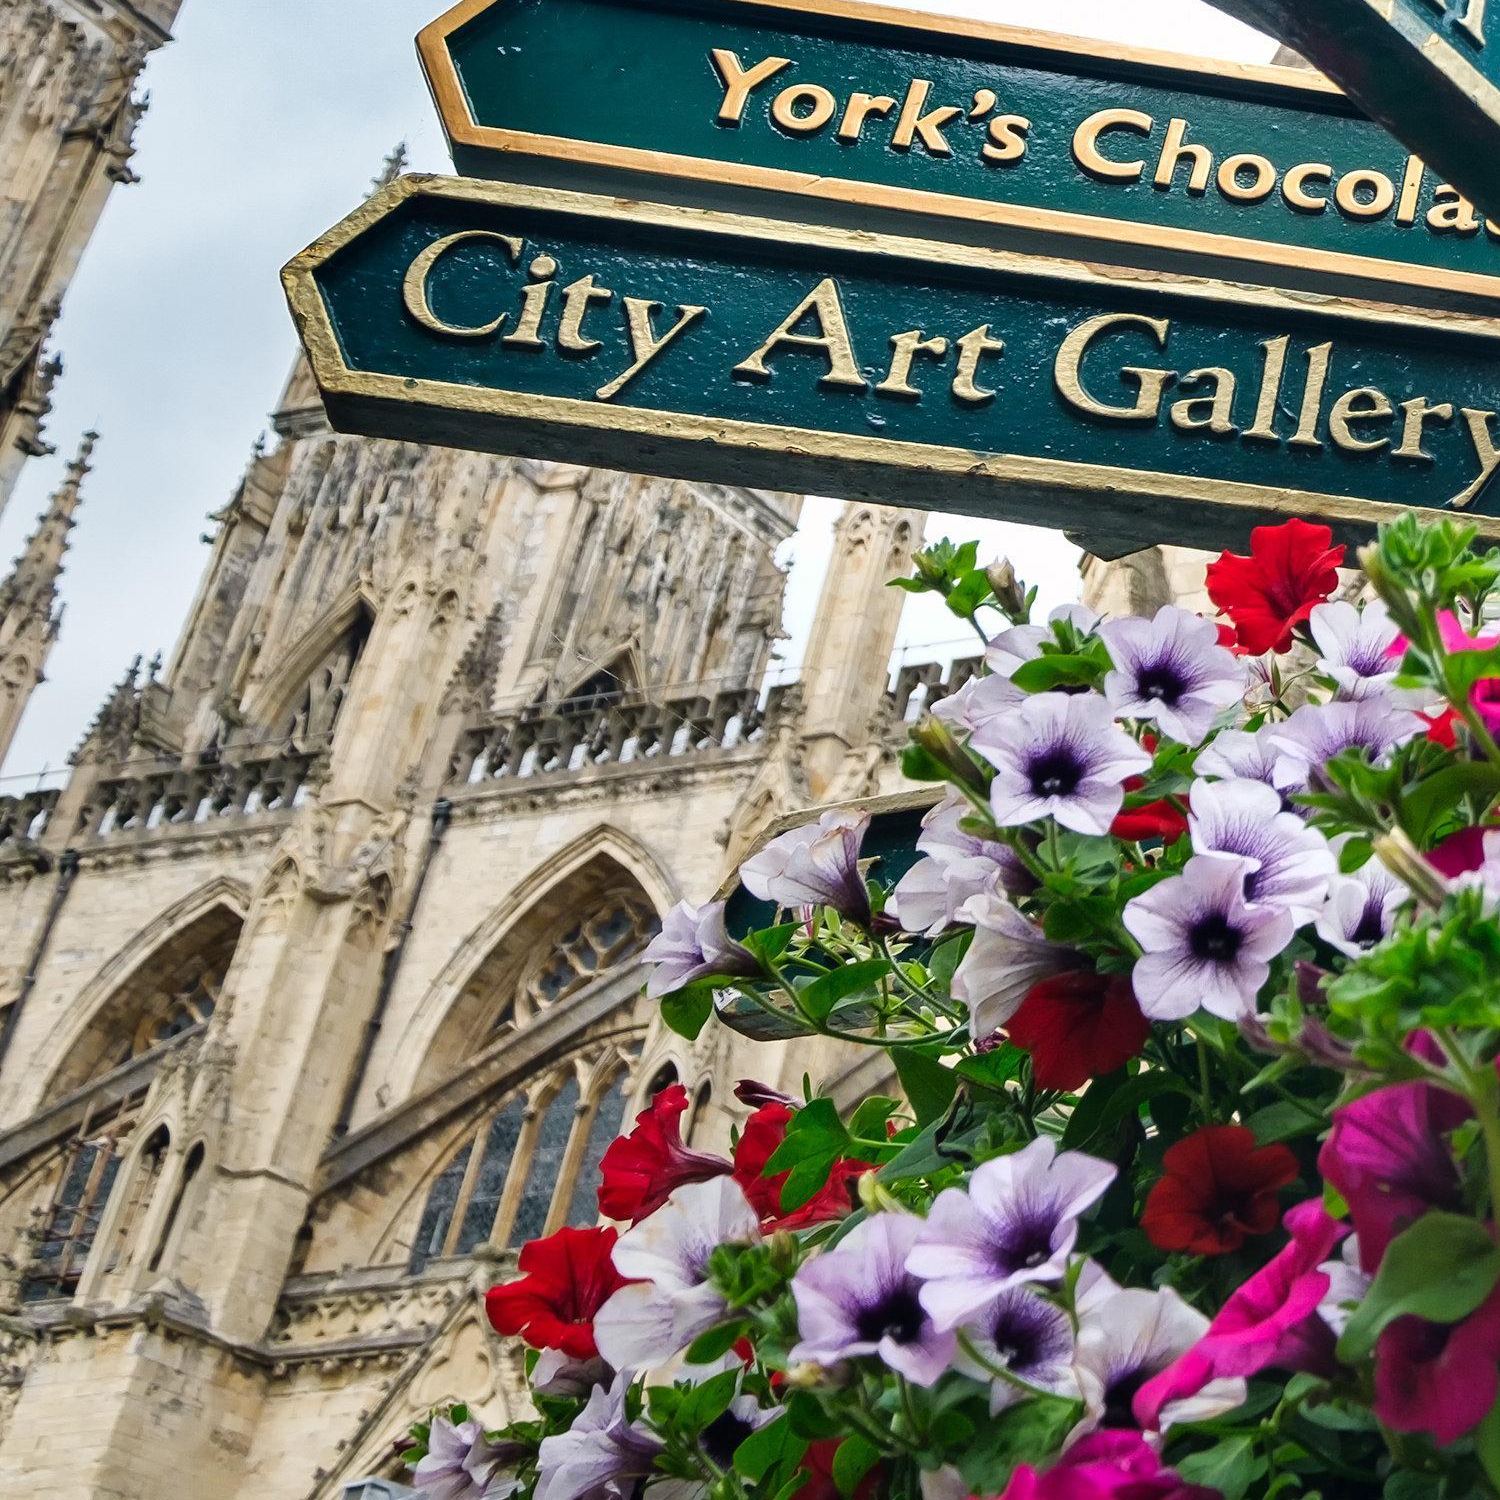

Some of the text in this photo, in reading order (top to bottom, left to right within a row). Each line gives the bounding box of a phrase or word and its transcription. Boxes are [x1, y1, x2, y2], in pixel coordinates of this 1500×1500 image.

[711, 48, 1031, 165] York's
[403, 229, 711, 400] City
[732, 278, 1004, 403] Art
